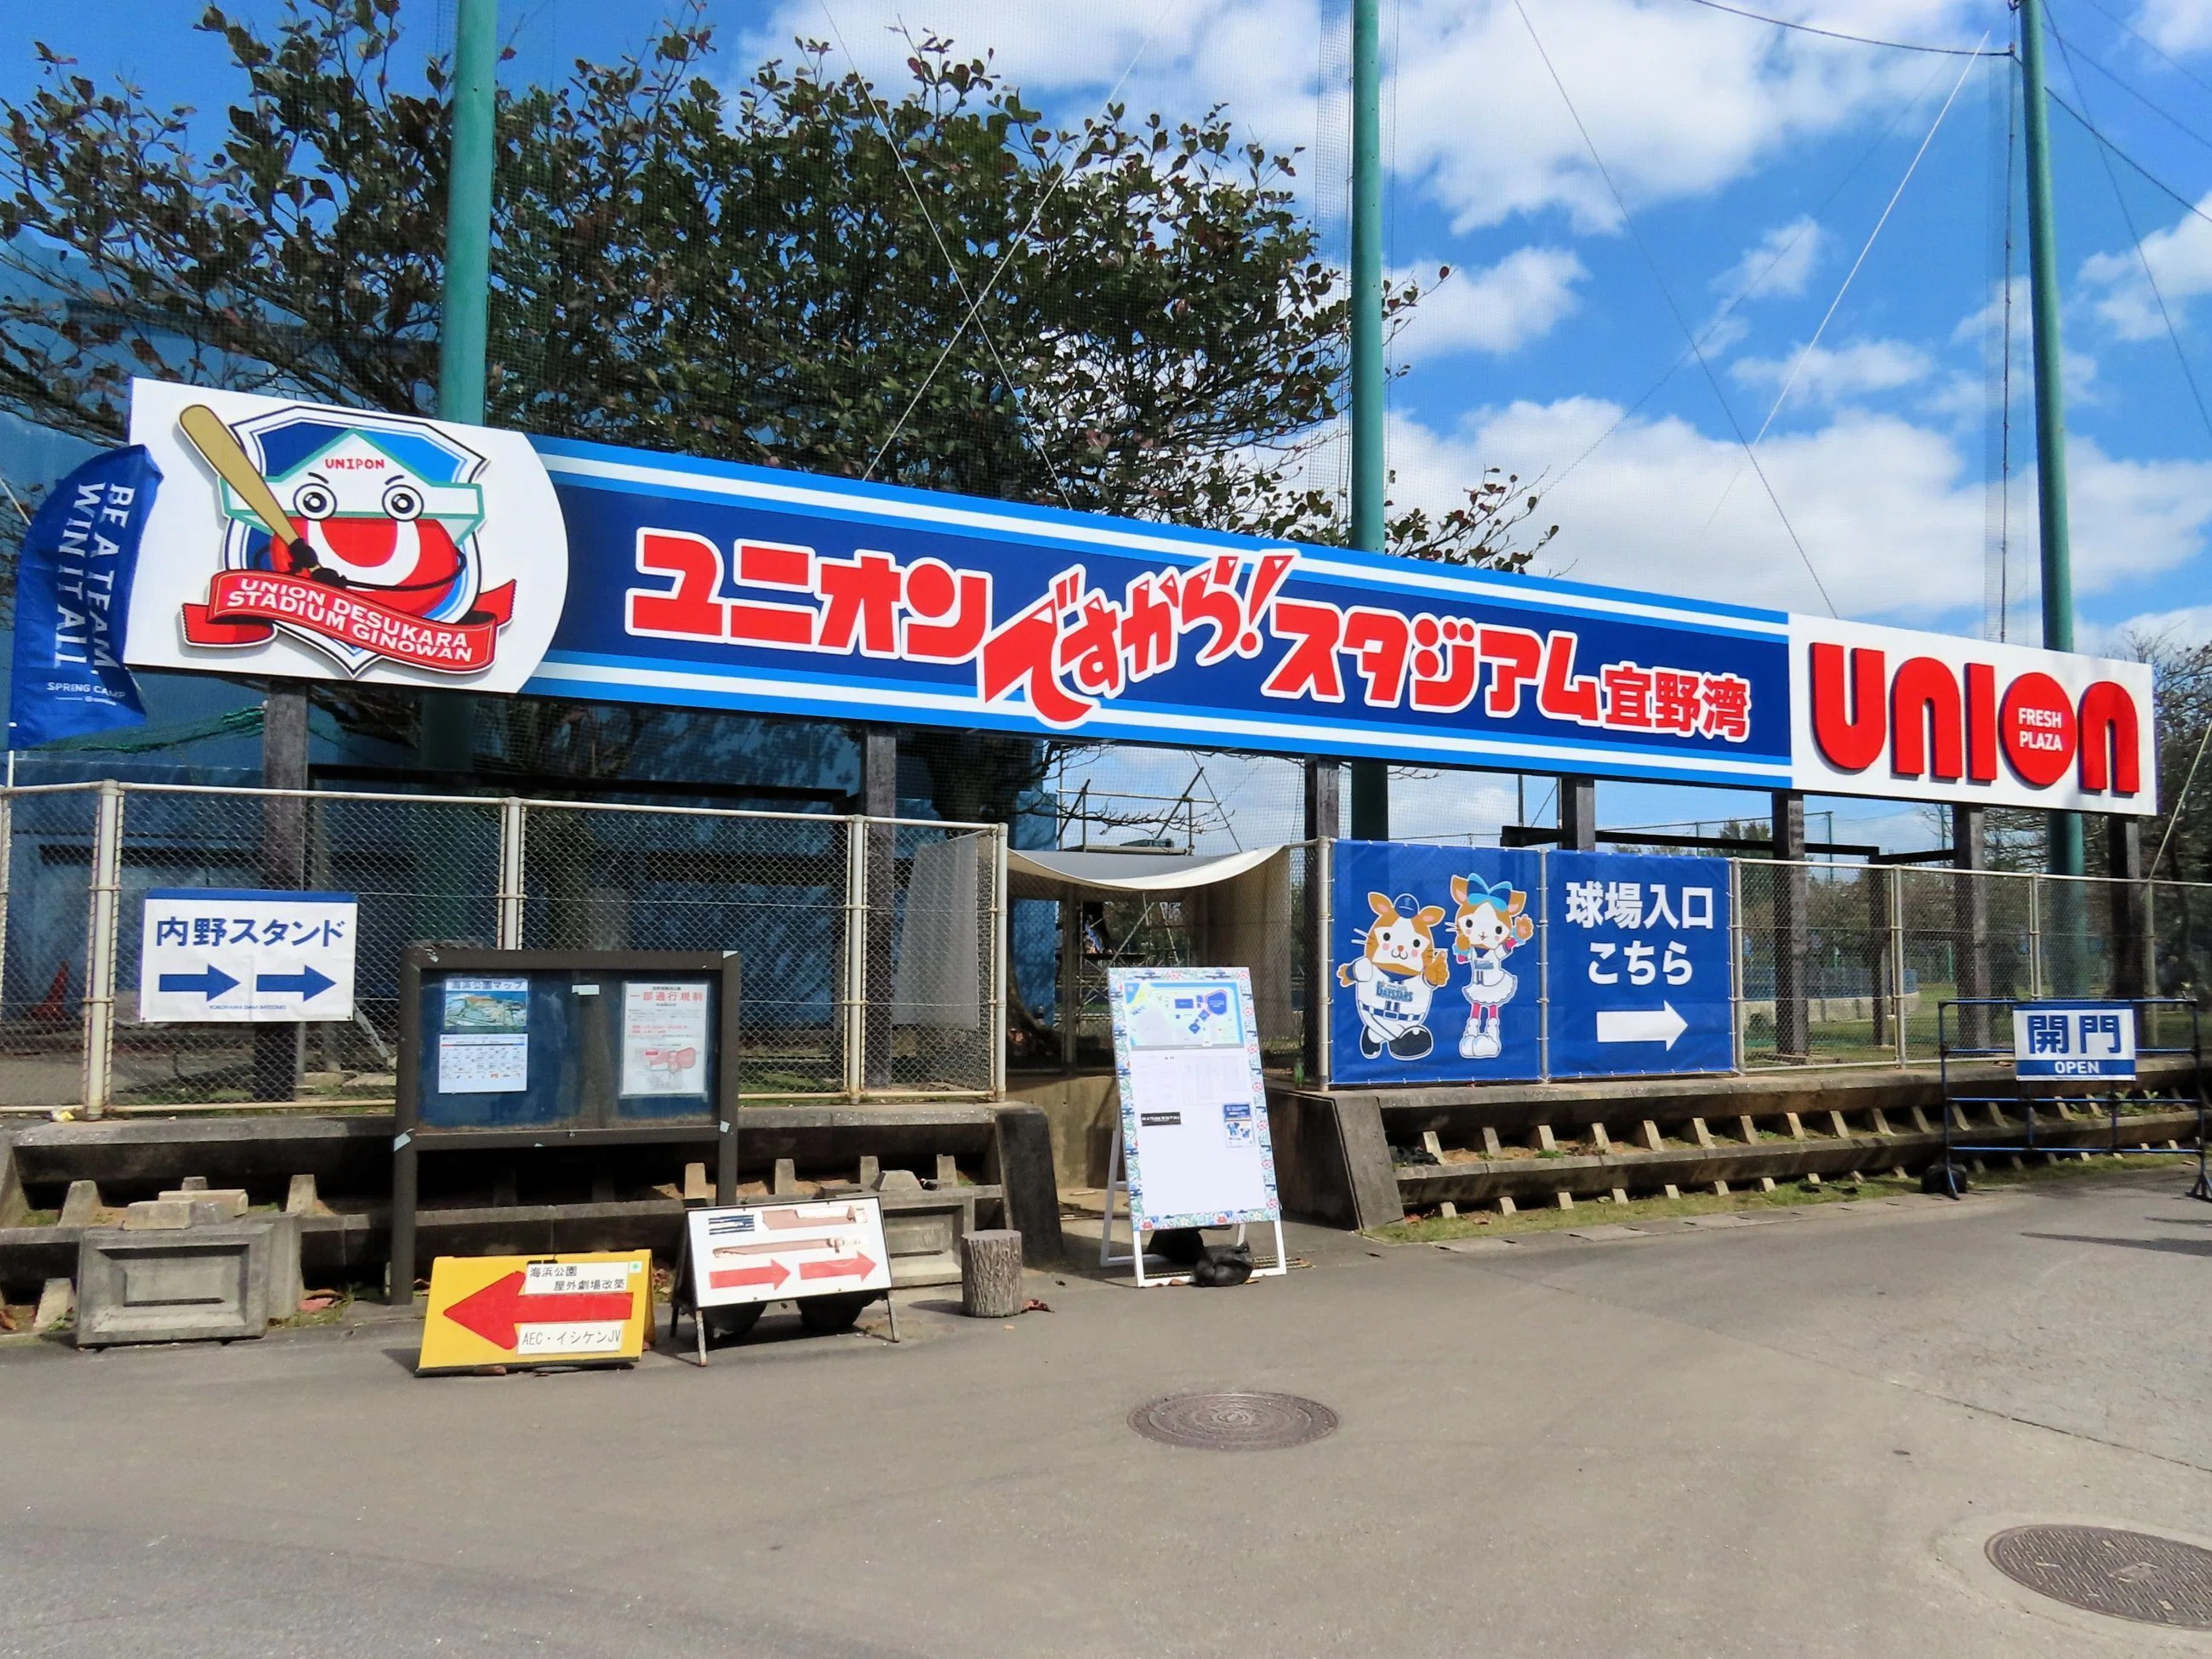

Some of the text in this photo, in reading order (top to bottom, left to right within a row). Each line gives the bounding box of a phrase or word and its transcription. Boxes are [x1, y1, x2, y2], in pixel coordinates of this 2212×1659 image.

[325, 458, 385, 470] UNIPON
[58, 482, 106, 558] WIN
[99, 482, 135, 529] BE
[89, 531, 120, 558] A
[58, 564, 83, 601] IT
[227, 591, 472, 662] STADIUM GINOWAN
[241, 579, 468, 648] UNION DESUKARA
[47, 681, 126, 698] SPRING CAMP
[1810, 641, 2140, 794] UNION
[2018, 707, 2062, 729] FRESH
[2019, 730, 2063, 752] PLAZA
[1565, 881, 1713, 929] 球場入口
[157, 916, 345, 947] 内野スタンド
[1588, 940, 1692, 985] こちら
[2027, 1015, 2122, 1054] 開門
[2055, 1061, 2100, 1074] OPEN
[530, 1266, 578, 1277] 海浜公園
[554, 1279, 625, 1291] 屋外劇場改築
